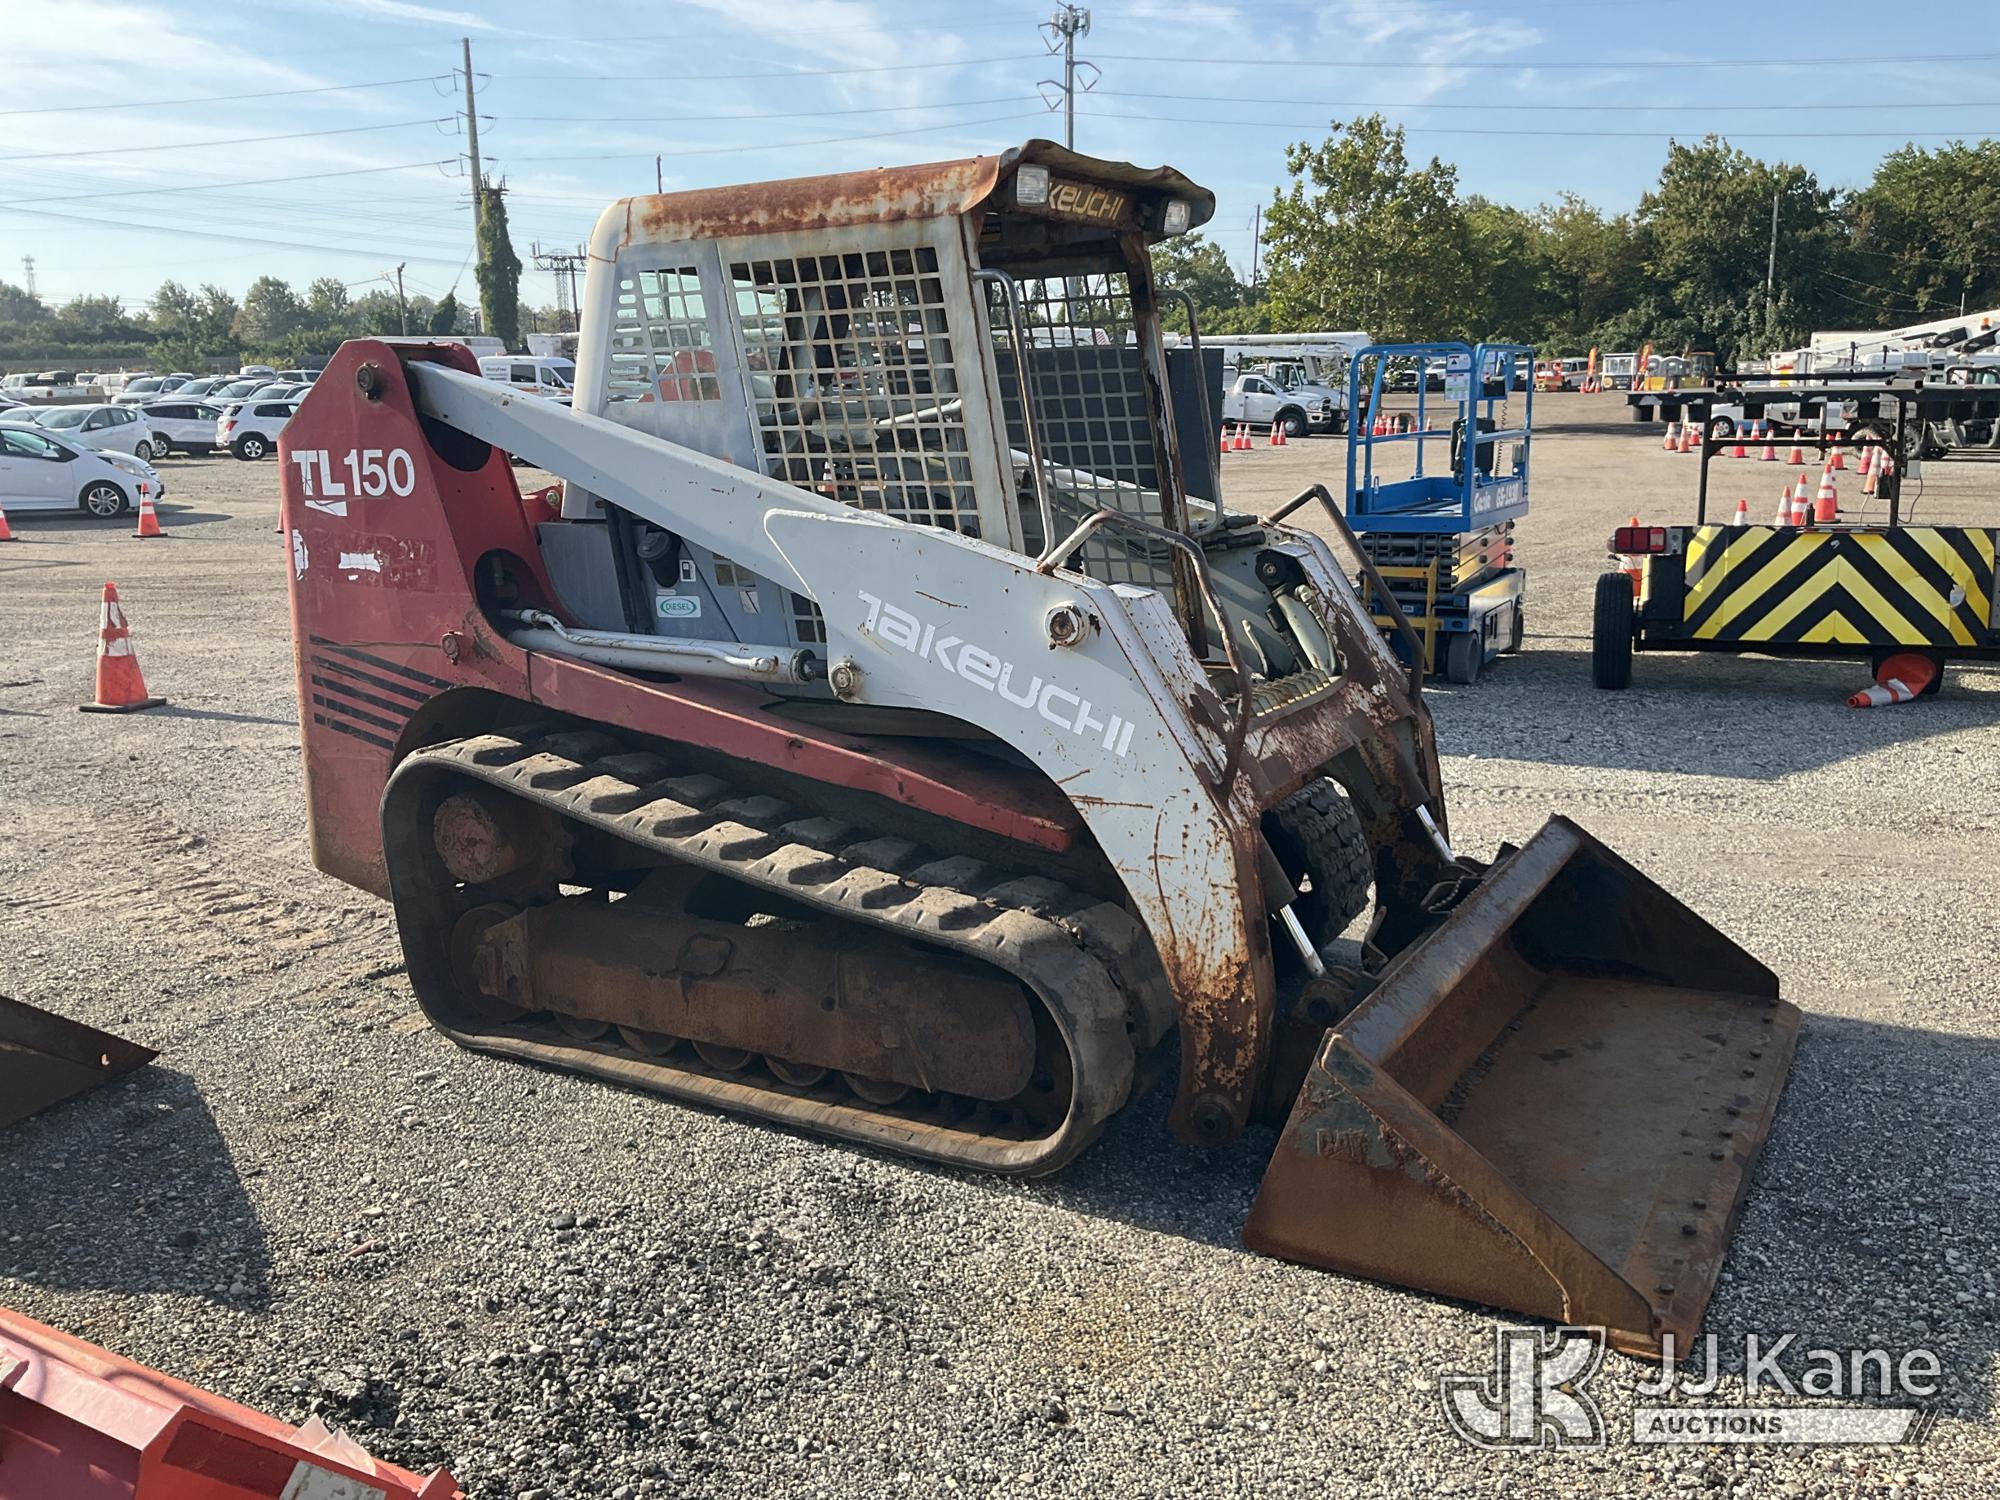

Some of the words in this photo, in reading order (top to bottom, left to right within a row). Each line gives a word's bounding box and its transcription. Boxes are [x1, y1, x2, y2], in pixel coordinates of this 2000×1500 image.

[1049, 181, 1125, 221] KEUCHI
[291, 448, 416, 497] TL150
[665, 603, 692, 611] DIESEL
